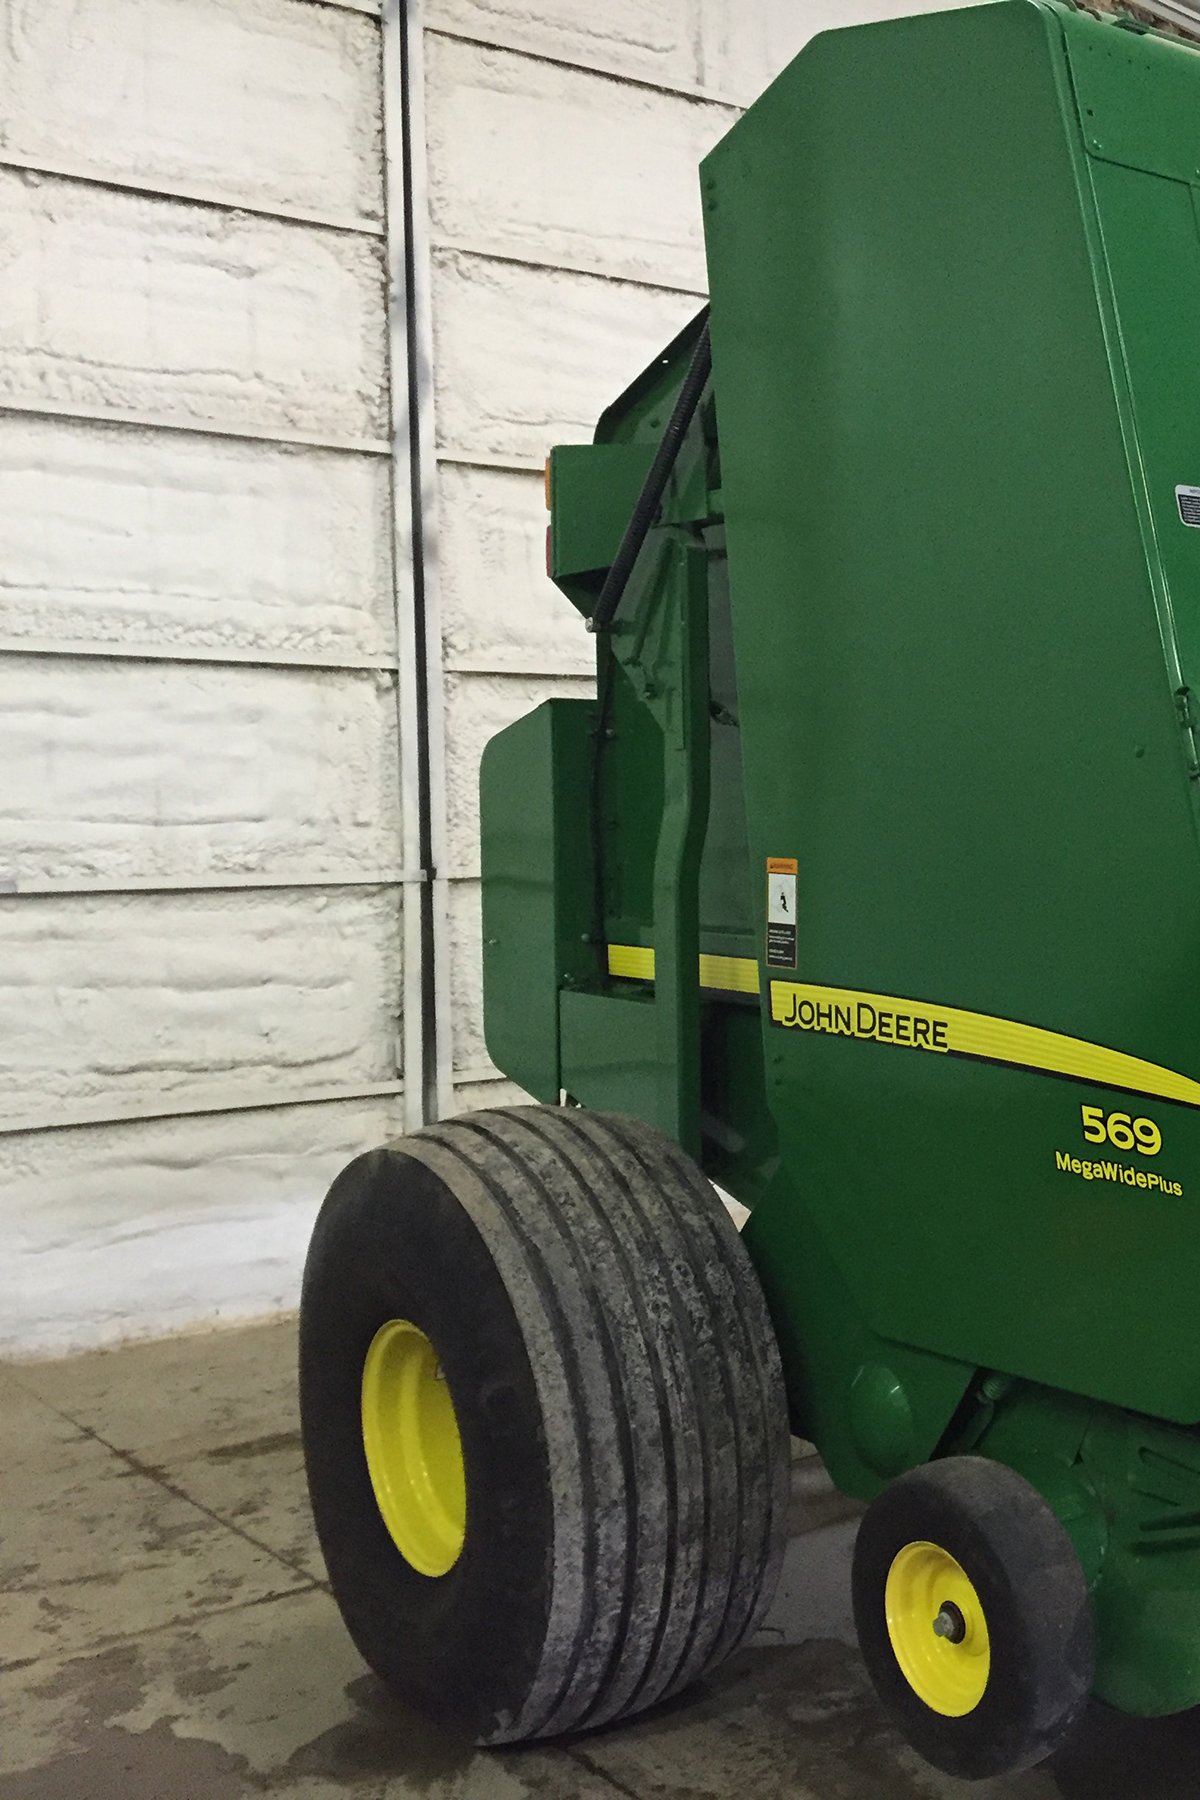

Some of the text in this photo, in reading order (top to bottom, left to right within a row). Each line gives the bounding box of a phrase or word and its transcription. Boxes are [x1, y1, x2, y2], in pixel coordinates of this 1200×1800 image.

[784, 993, 949, 1049] JOHN DEERE
[1081, 1104, 1162, 1156] 569
[1055, 1150, 1183, 1197] MegaWidePlus
